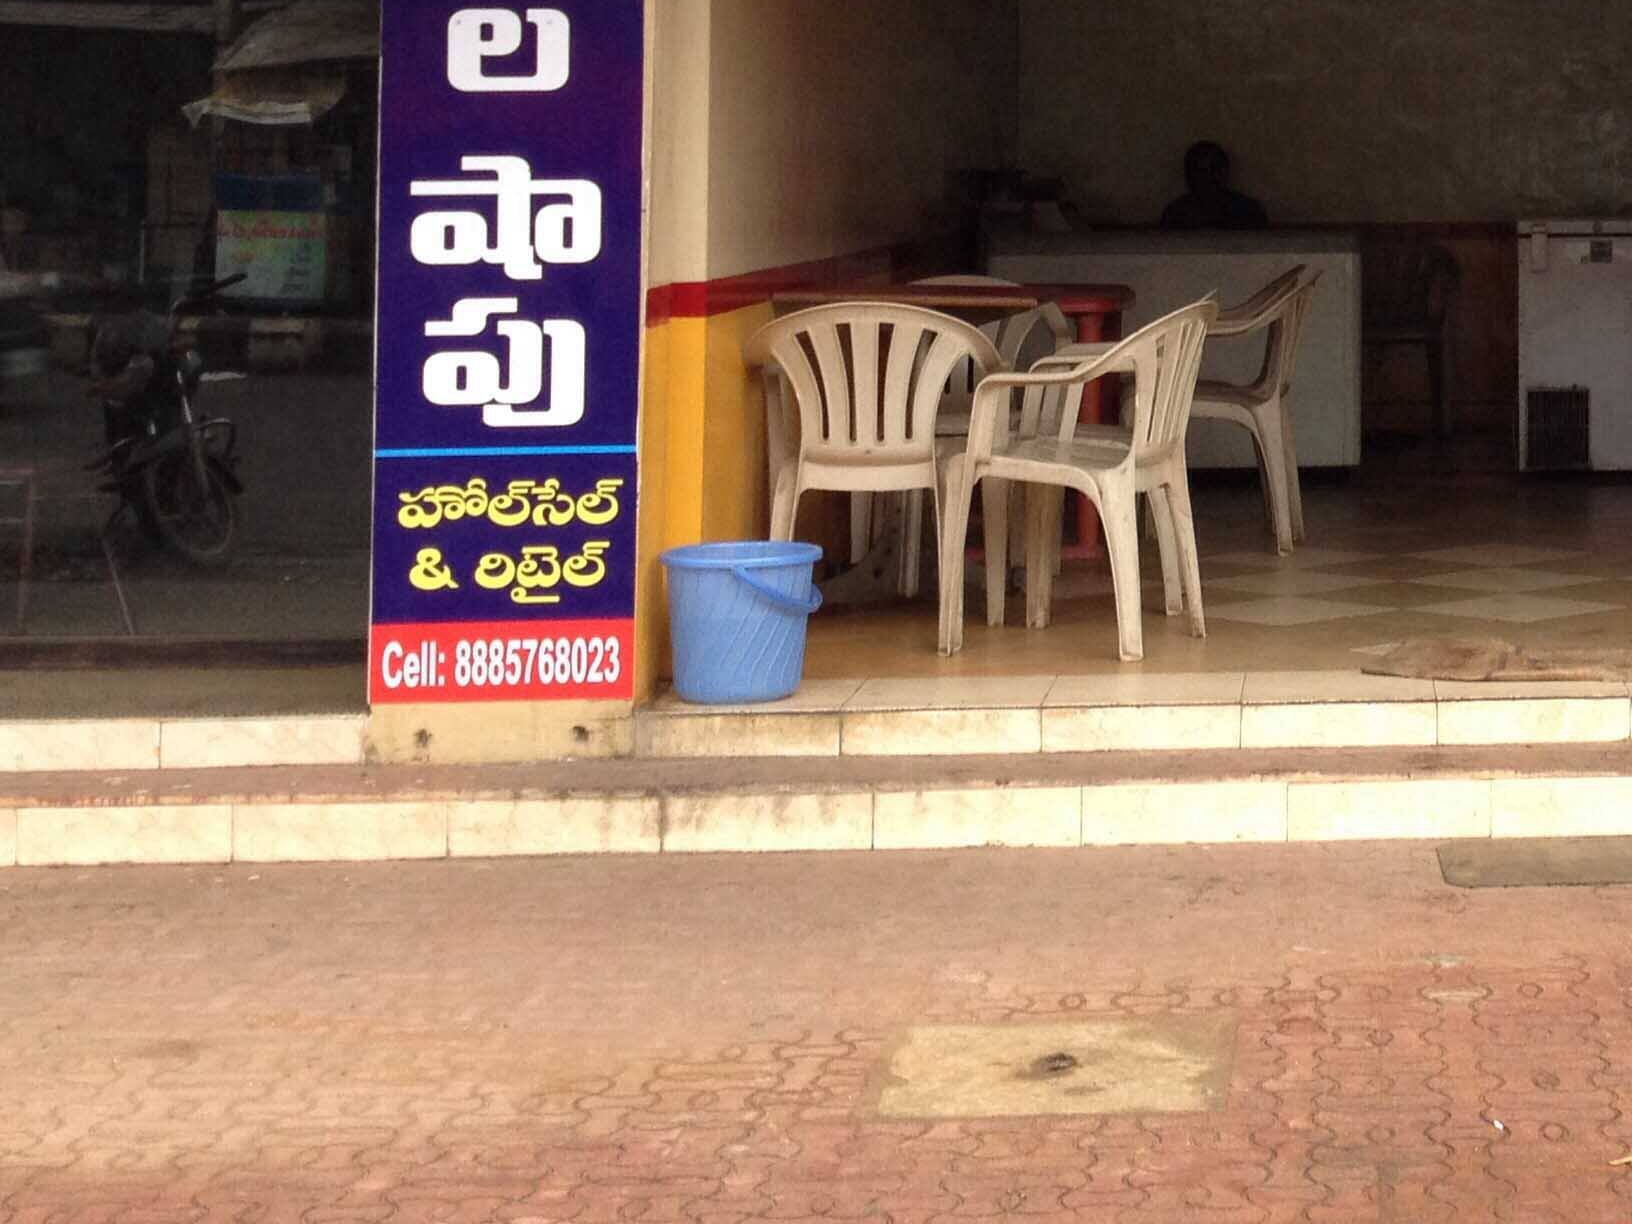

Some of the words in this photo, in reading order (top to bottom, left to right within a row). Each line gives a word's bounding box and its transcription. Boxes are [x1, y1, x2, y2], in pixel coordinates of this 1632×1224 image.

[409, 547, 460, 591] &
[474, 541, 611, 604] రిటైల్
[382, 640, 446, 688] Cell:
[454, 636, 621, 688] 8885768023
